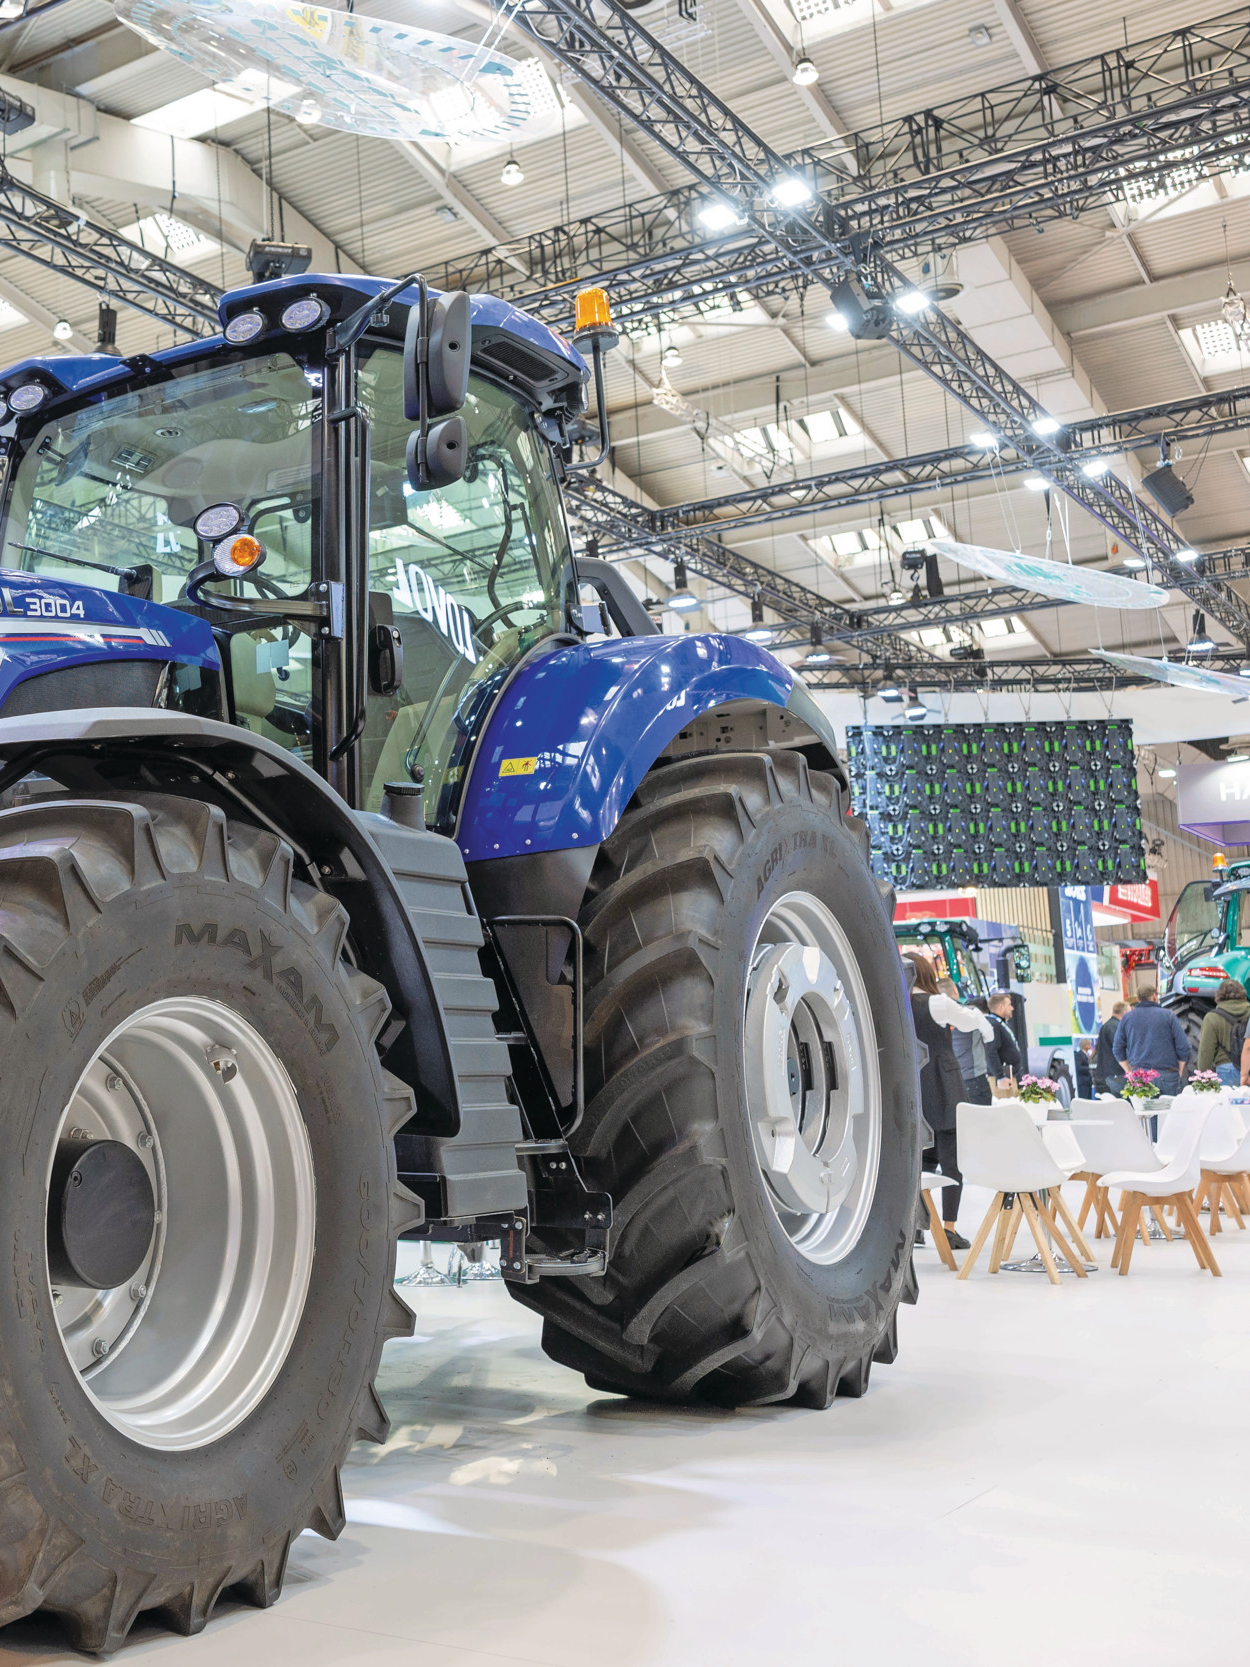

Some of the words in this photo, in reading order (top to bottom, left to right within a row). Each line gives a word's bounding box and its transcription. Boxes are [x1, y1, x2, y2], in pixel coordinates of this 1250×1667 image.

[25, 597, 85, 618] 3004
[173, 922, 341, 1054] MAXAM
[181, 1493, 248, 1530] AGRI
